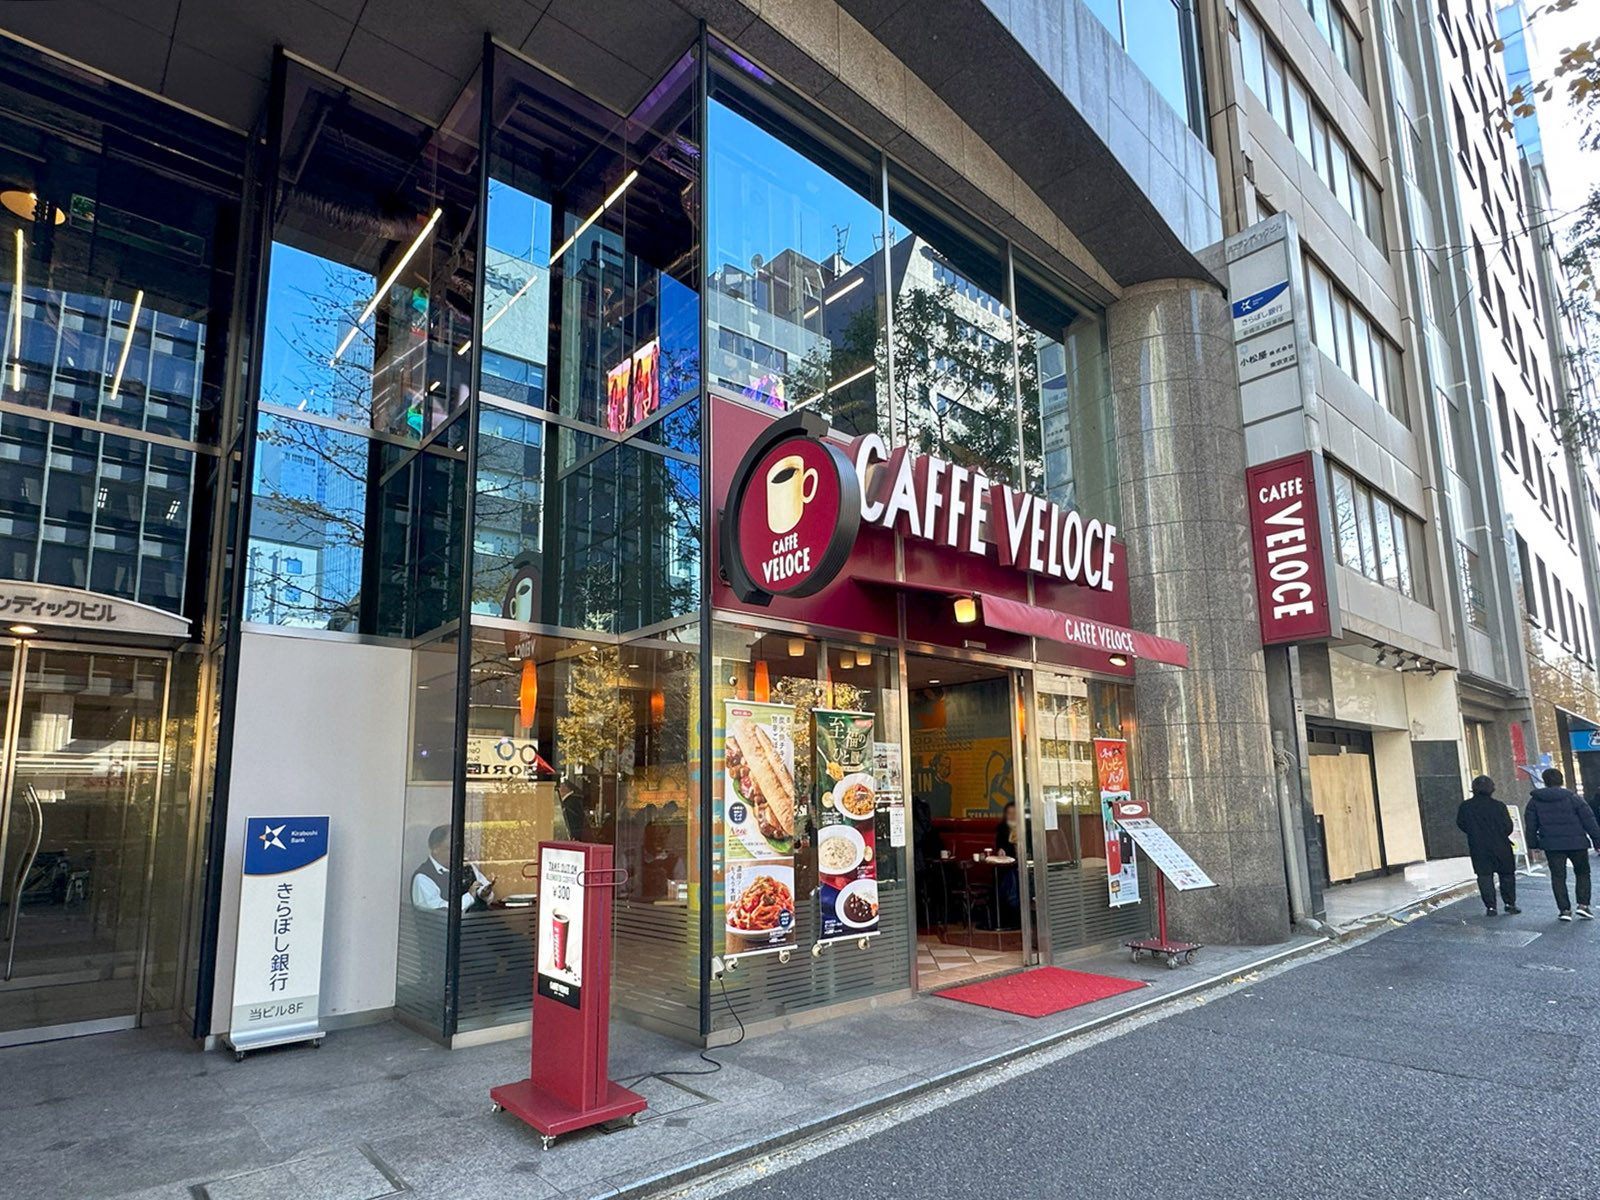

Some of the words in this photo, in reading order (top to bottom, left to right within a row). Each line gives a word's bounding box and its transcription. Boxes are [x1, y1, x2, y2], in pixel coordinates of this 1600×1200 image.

[1240, 350, 1268, 367] 小松屋
[1002, 484, 1117, 592] VELOCE
[762, 547, 810, 584] VELOCE
[1264, 500, 1314, 620] VELOCE
[1097, 626, 1135, 653] VELOCE
[828, 716, 866, 749] 至福の
[1101, 757, 1123, 772] ハッピー
[269, 882, 293, 992] きらぼし銀行
[249, 1003, 303, 1021] 当ビル8F
